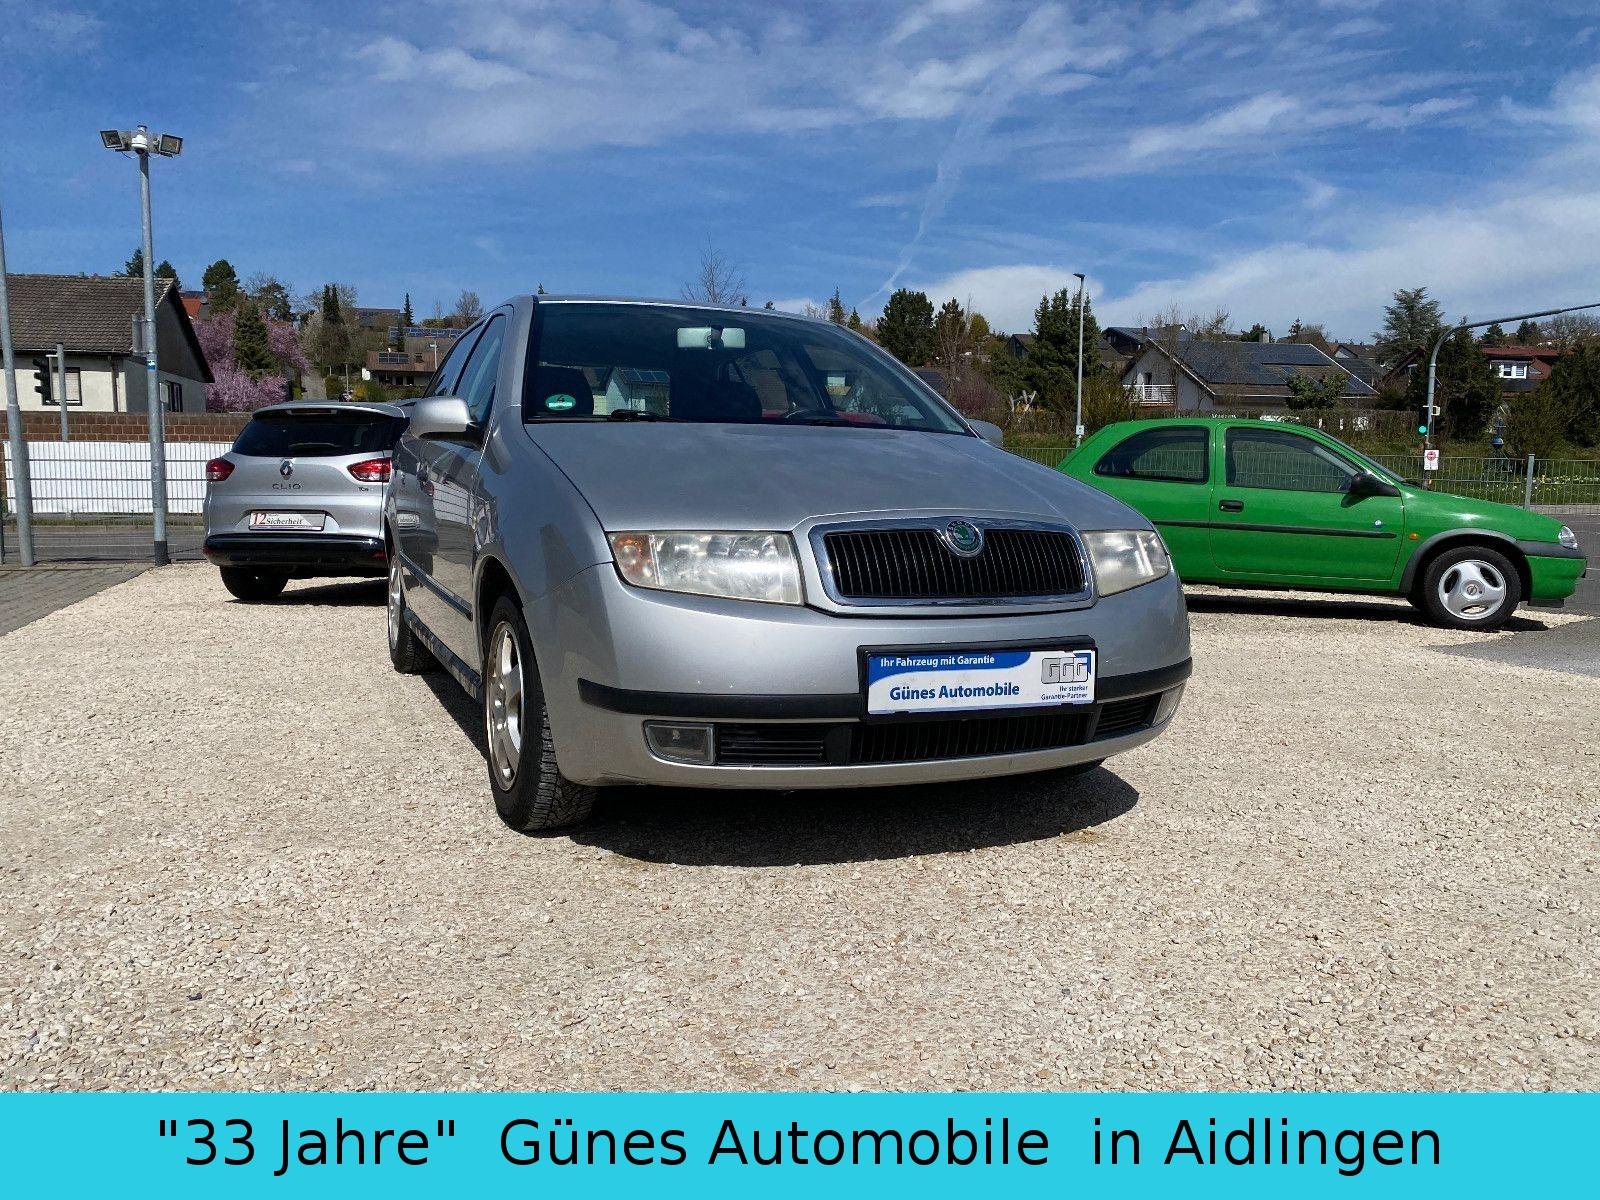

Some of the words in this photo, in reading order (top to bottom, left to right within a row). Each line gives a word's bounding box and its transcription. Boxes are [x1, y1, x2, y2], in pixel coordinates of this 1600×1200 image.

[253, 512, 267, 525] 12
[267, 517, 303, 525] Sicherheit
[880, 658, 895, 667] Ihr
[896, 656, 939, 668] Fahrzeug
[940, 655, 956, 666] mit
[957, 654, 995, 665] Garantie
[889, 685, 936, 701] Günes
[938, 681, 1020, 698] Automobile
[1041, 692, 1089, 700] Garantie-Partner
